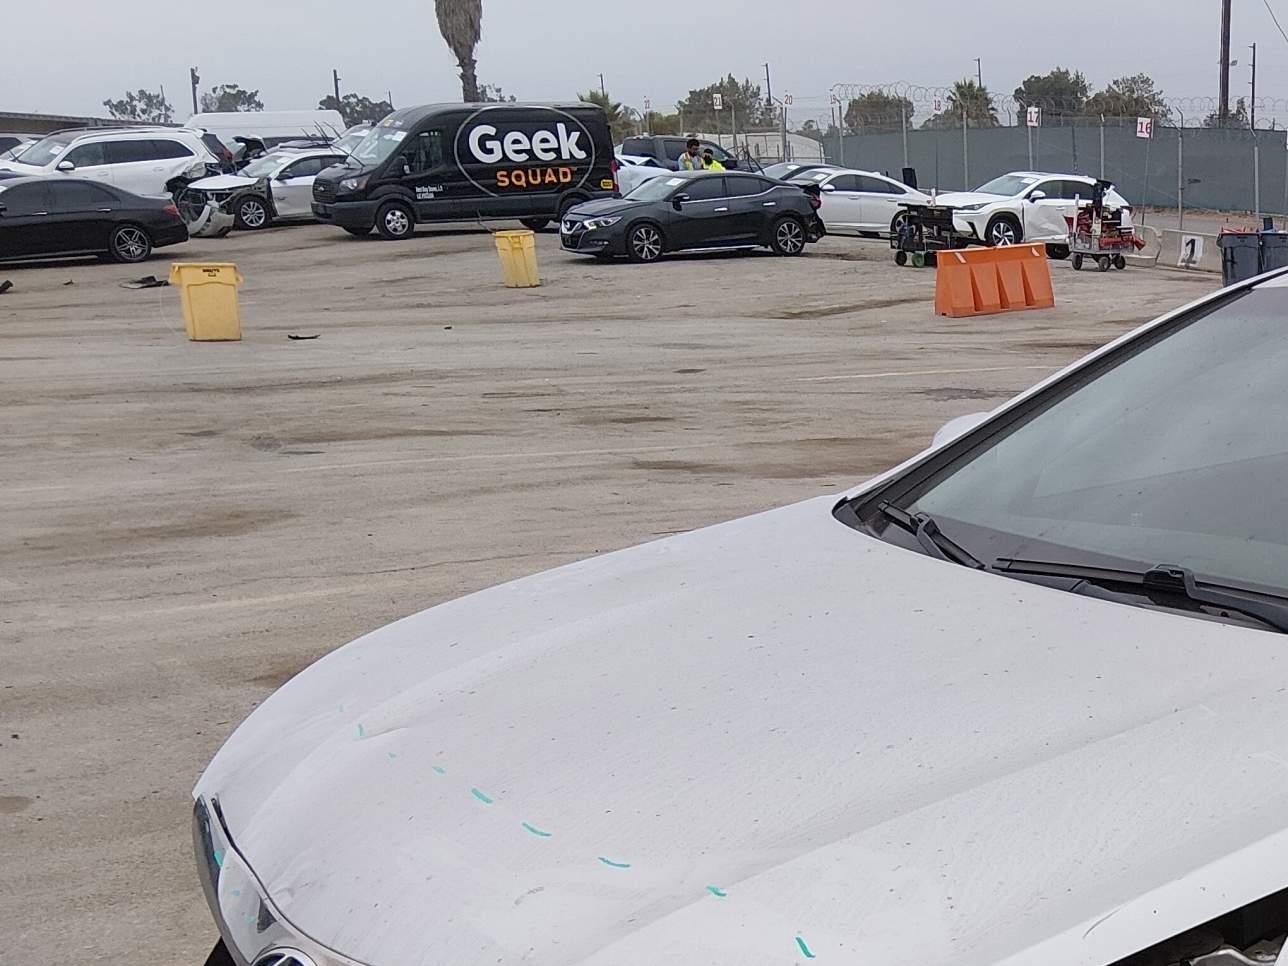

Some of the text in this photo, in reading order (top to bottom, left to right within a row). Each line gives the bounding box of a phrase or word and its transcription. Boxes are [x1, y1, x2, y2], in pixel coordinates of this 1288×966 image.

[784, 94, 793, 105] 20
[1028, 110, 1040, 123] 17
[1137, 121, 1153, 134] 16
[468, 123, 587, 164] Geek
[496, 167, 573, 187] SQUAD
[1180, 238, 1197, 265] 1
